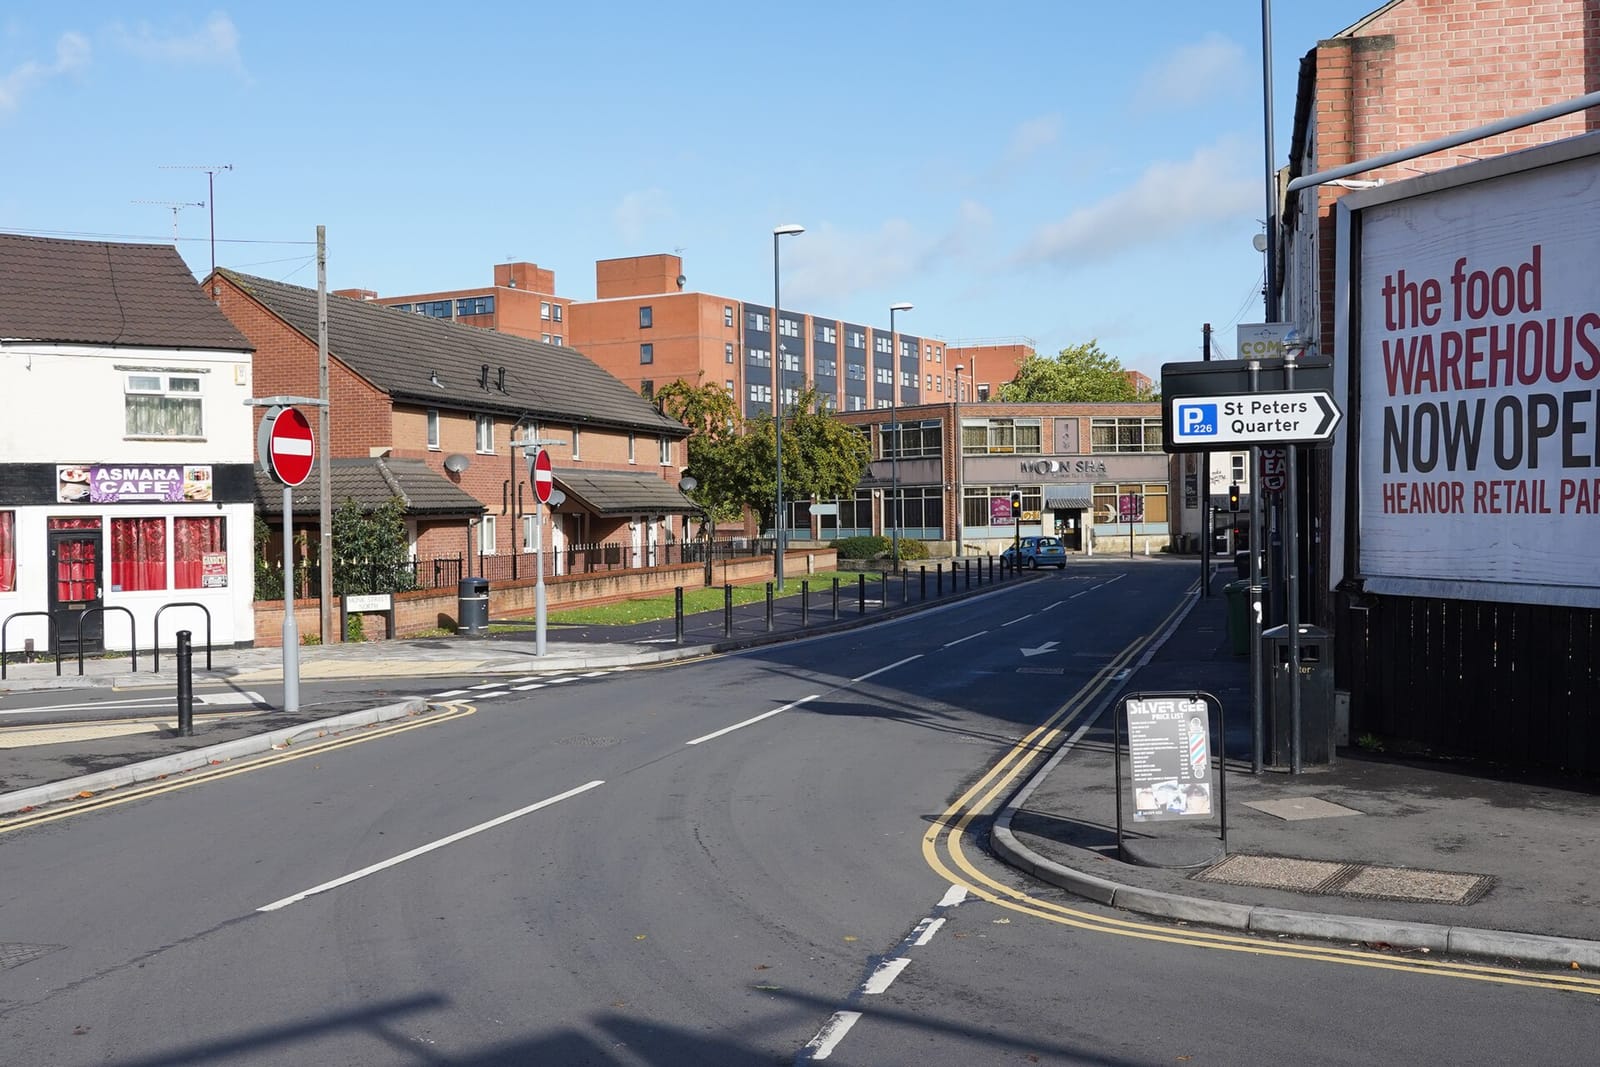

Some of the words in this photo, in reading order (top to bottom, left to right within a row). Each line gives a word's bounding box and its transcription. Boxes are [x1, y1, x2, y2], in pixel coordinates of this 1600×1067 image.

[1382, 269, 1441, 331] the
[1451, 245, 1541, 322] food
[1382, 313, 1600, 397] WAREHOUS
[1224, 402, 1244, 415] St
[1251, 401, 1307, 414] Peters
[1183, 408, 1204, 434] P
[1231, 418, 1300, 434] Quarter
[1193, 424, 1213, 433] 226
[1383, 398, 1486, 474] NOW
[1494, 390, 1600, 470] OPE
[1075, 460, 1106, 473] SHA
[96, 469, 180, 480] ASMARA
[100, 481, 170, 494] CAFE
[1383, 481, 1465, 514] HEANOR
[1474, 480, 1551, 514] RETAIL
[1178, 701, 1205, 712] GEE
[1170, 712, 1184, 720] LIST
